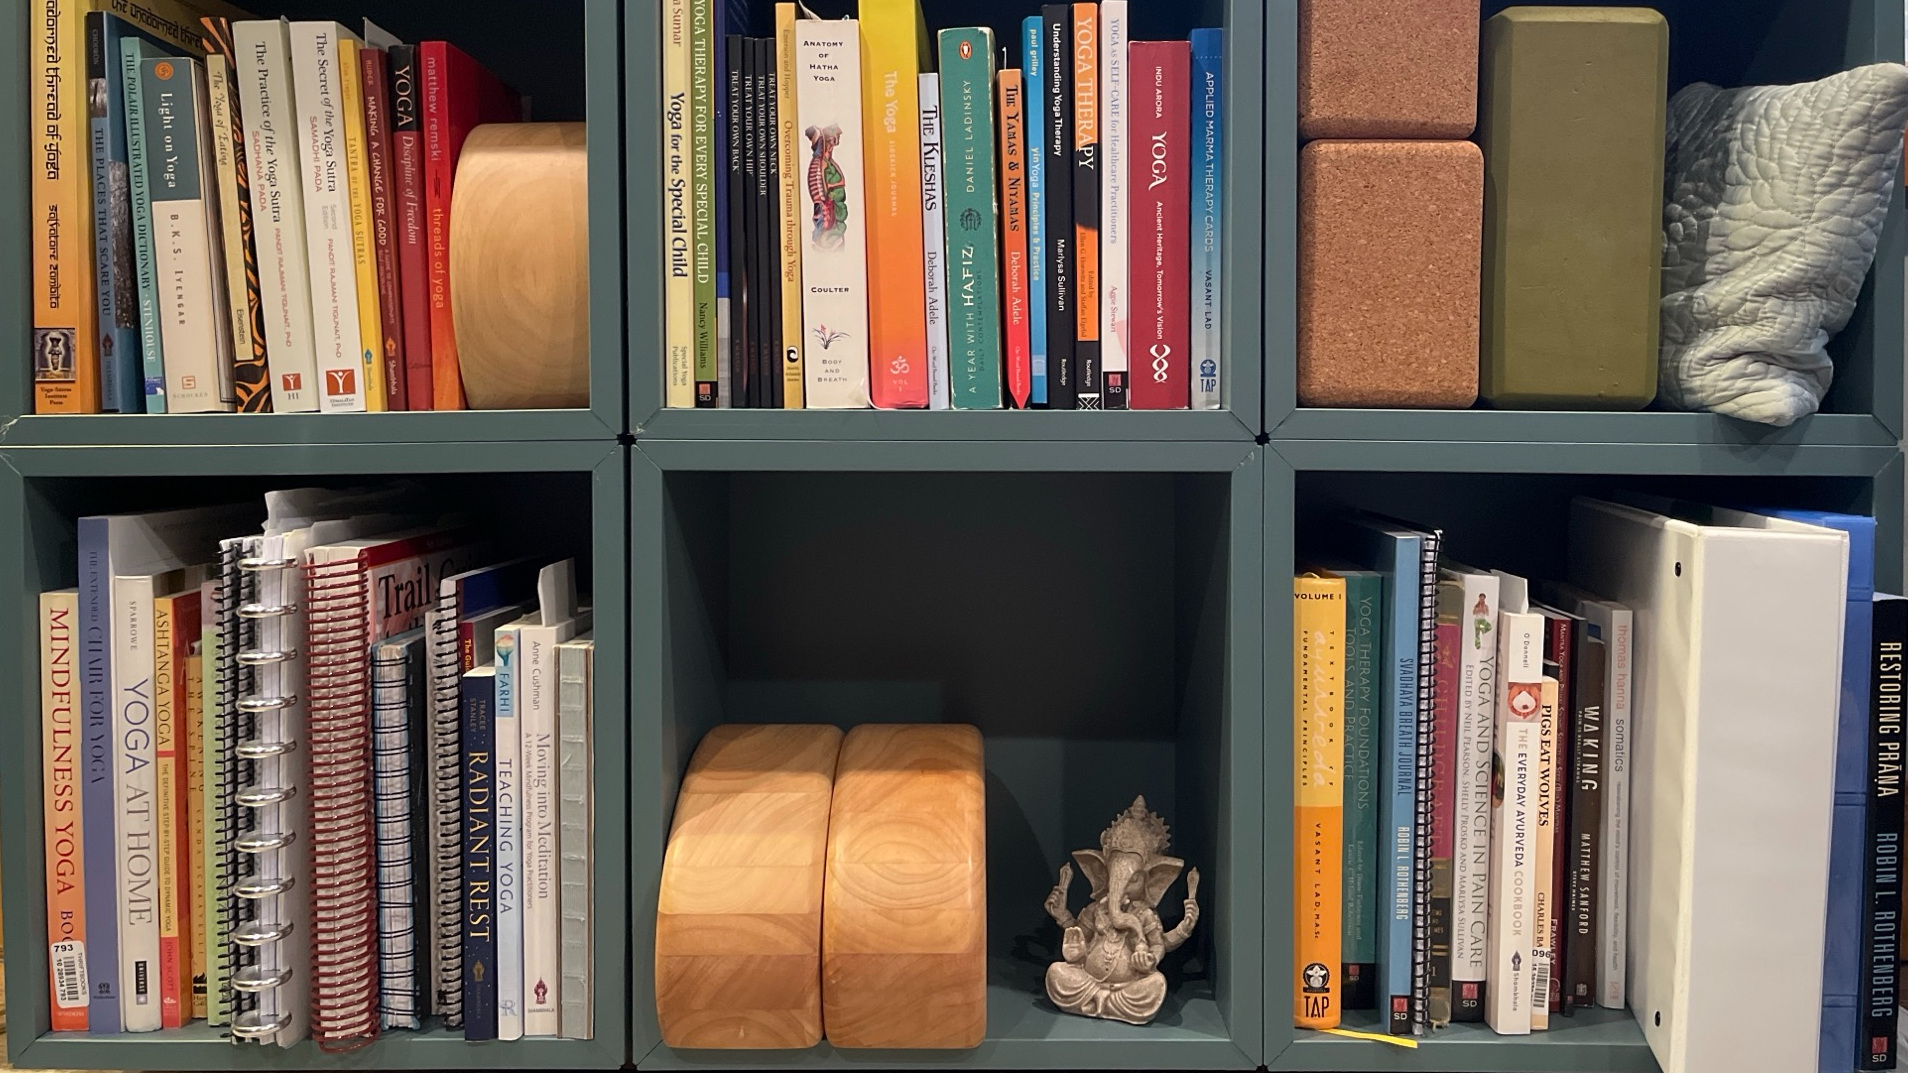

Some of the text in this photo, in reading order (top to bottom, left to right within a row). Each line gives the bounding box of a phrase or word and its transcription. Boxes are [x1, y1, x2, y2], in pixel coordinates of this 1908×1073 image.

[45, 67, 61, 120] thread
[126, 53, 135, 74] THE
[127, 77, 138, 116] POLAIR
[395, 65, 413, 127] YOGA
[427, 57, 441, 161] matthew remski
[1051, 23, 1063, 156] Understanding Yoga Therapy
[1077, 17, 1094, 170] YOGA THERAPY
[46, 125, 61, 141] of
[130, 118, 143, 188] ILLUSTRATED
[158, 93, 178, 188] Light on Yoga
[213, 71, 228, 166] The Yoga of Eating
[255, 42, 282, 222] The Practice of the Yoga Sutra
[315, 33, 336, 192] The Secret of the Yoga Sutra
[694, 0, 709, 283] YOGA THERAPY FOR EVERY SPECIAL CHILD
[923, 105, 939, 211] THE KLESHAS
[963, 81, 975, 193] DANIEL LADINSKY
[1005, 85, 1021, 231] THE YAMAS & NIYAMAS
[44, 143, 61, 180] yoga
[134, 192, 148, 222] YOGA
[401, 136, 418, 244] Discipline of Freedom
[668, 93, 688, 277] Yoga for the Special Child
[783, 121, 798, 282] Overcoming Trauma through Yoga
[1148, 131, 1167, 191] YOGA
[1205, 72, 1214, 252] APPLIED MARMA THERAPY CARDS
[95, 128, 111, 316] THE PLACES THAT SCARE YOU
[138, 224, 150, 290] DICTIONARY
[433, 209, 445, 308] threads of yoga
[1156, 233, 1164, 268] Heritage,
[928, 251, 938, 325] Deborah Adele
[1010, 251, 1022, 325] Deborah Adele
[1056, 239, 1066, 311] Marlysa Sullivan
[143, 299, 155, 362] STENHOUSE
[236, 309, 246, 344] Eisenstein
[698, 302, 708, 369] Nancy Williams
[1200, 379, 1216, 392] TAP
[130, 601, 138, 650] SPARROWE
[378, 562, 432, 619] Trail
[157, 610, 171, 745] ASHTANGA YOGA
[499, 673, 510, 712] FARHI
[532, 641, 542, 711] Anne Cushman
[1358, 597, 1372, 809] YOGA THERAPY FOUNDATIONS
[1616, 625, 1628, 709] thomas hanna
[1878, 642, 1902, 734] RESTORING
[50, 607, 75, 895] MINDFULNESS YOGA
[1398, 658, 1414, 795] SVADHAYA BREATH JOURNAL
[1540, 705, 1552, 826] PIGS EAT WOLVES
[1582, 706, 1600, 790] WAKING
[1614, 719, 1626, 771] somatics
[124, 679, 152, 926] YOGA AT HOME
[469, 751, 490, 942] RADIANT REST
[499, 758, 513, 914] TEACHING YOGA
[533, 733, 551, 899] Moving into Meditation
[1397, 827, 1409, 853] ROBIN
[1469, 656, 1494, 968] YOGA AND SCIENCE IN PAIN CARE
[1513, 729, 1528, 936] THE EVERYDAY AYURVEDA COOKBOOK
[1396, 866, 1409, 920] ROTHENBERG
[1578, 833, 1591, 934] MATTHEW SANFORD
[1871, 832, 1898, 1018] ROBIN L. ROTHENBERG
[77, 952, 87, 995] THRIFTBOOKS
[1304, 996, 1330, 1018] TAP
